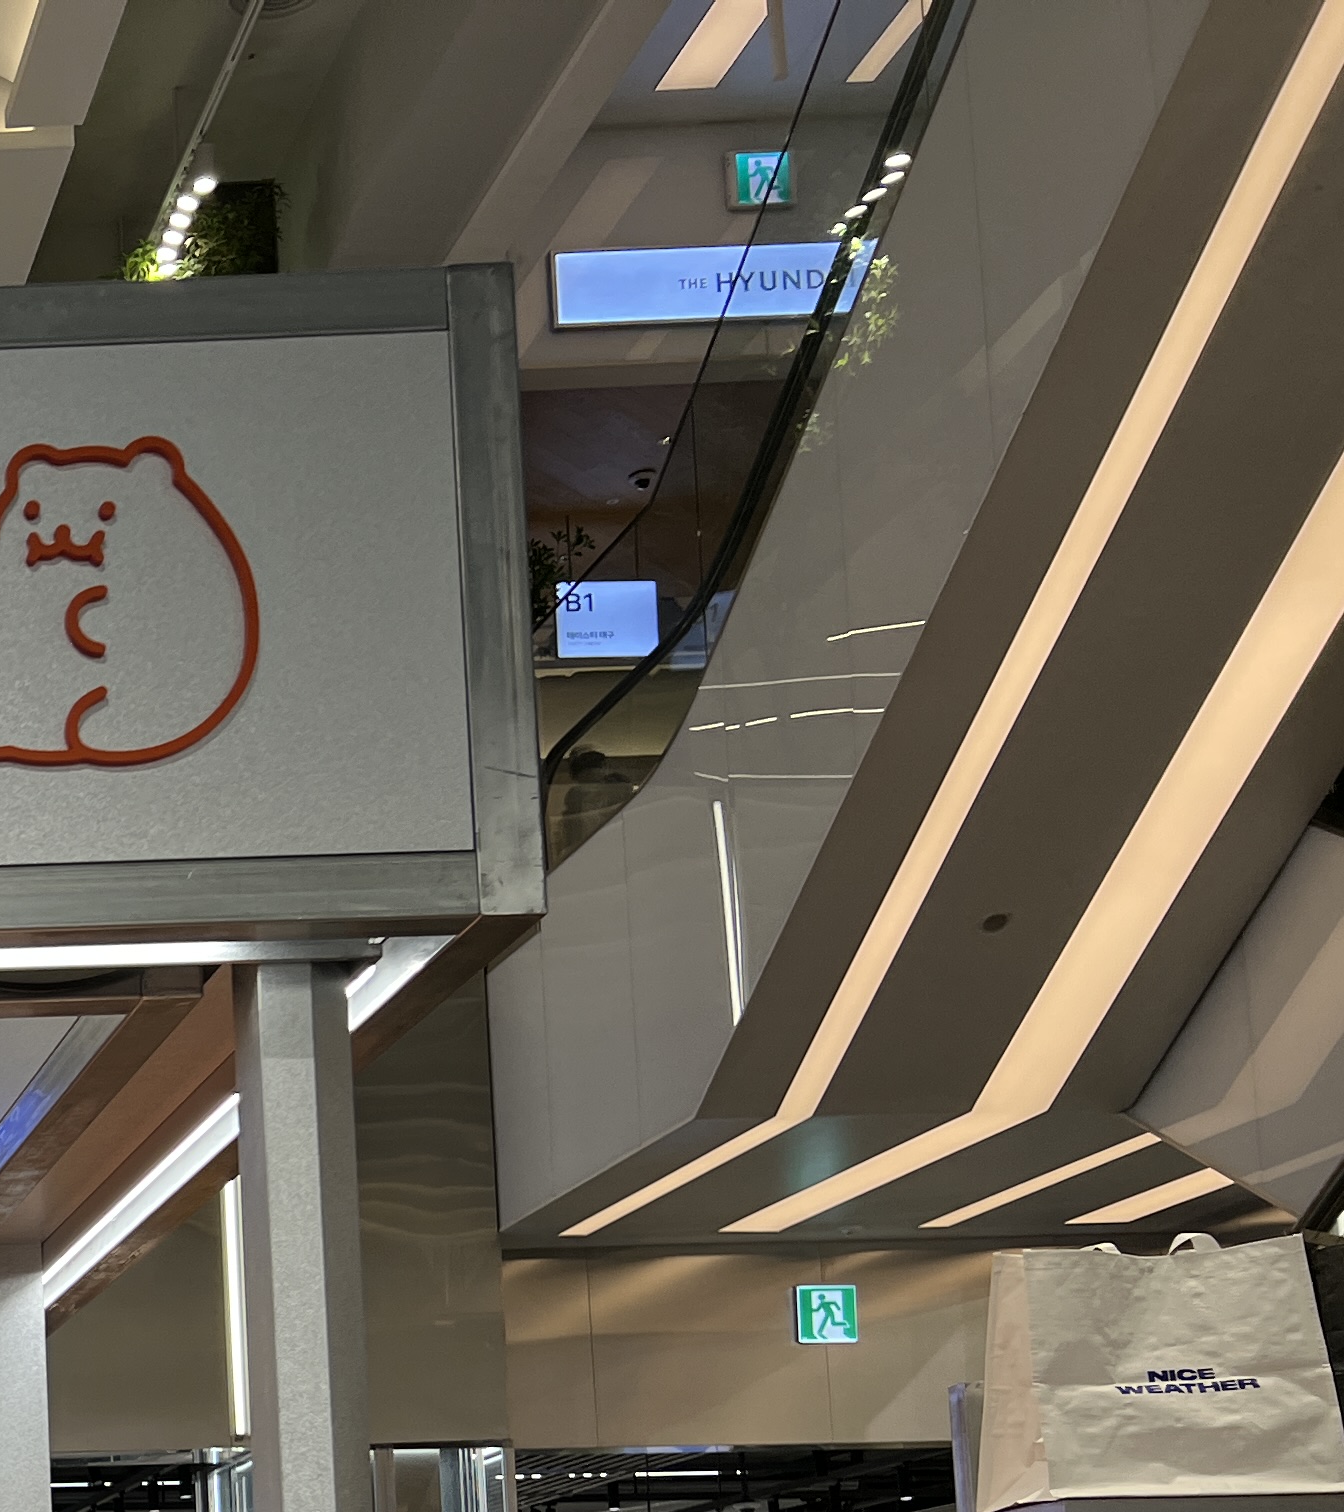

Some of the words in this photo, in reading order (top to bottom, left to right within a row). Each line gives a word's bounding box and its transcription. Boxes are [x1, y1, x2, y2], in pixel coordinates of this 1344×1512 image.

[678, 278, 708, 291] THE
[716, 268, 858, 293] HYUNDI
[566, 593, 594, 612] B1
[1147, 1368, 1216, 1382] NICE
[1115, 1378, 1261, 1395] WEATHER
